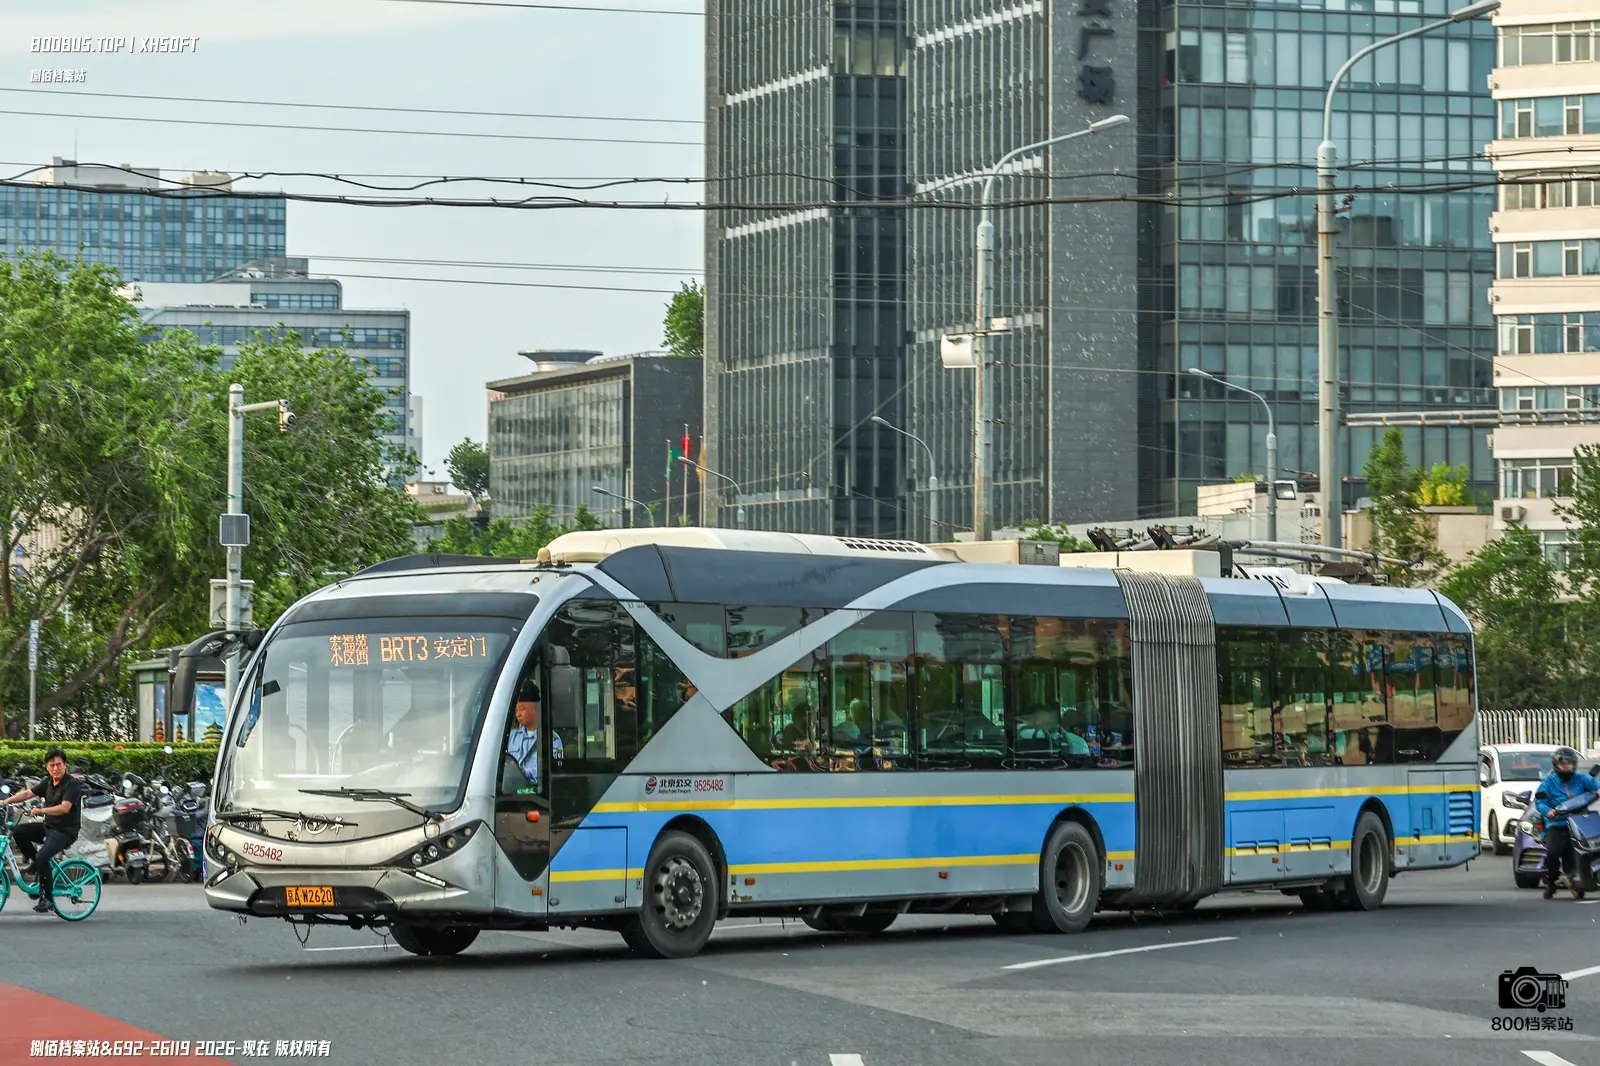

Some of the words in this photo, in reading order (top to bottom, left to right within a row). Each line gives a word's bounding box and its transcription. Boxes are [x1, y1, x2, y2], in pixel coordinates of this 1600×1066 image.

[380, 635, 429, 662] BRT3
[433, 635, 487, 660] 安定门
[330, 650, 370, 667] 小区西
[659, 778, 692, 788] 北京公交
[694, 779, 724, 791] 9525482
[242, 842, 283, 862] 9525482
